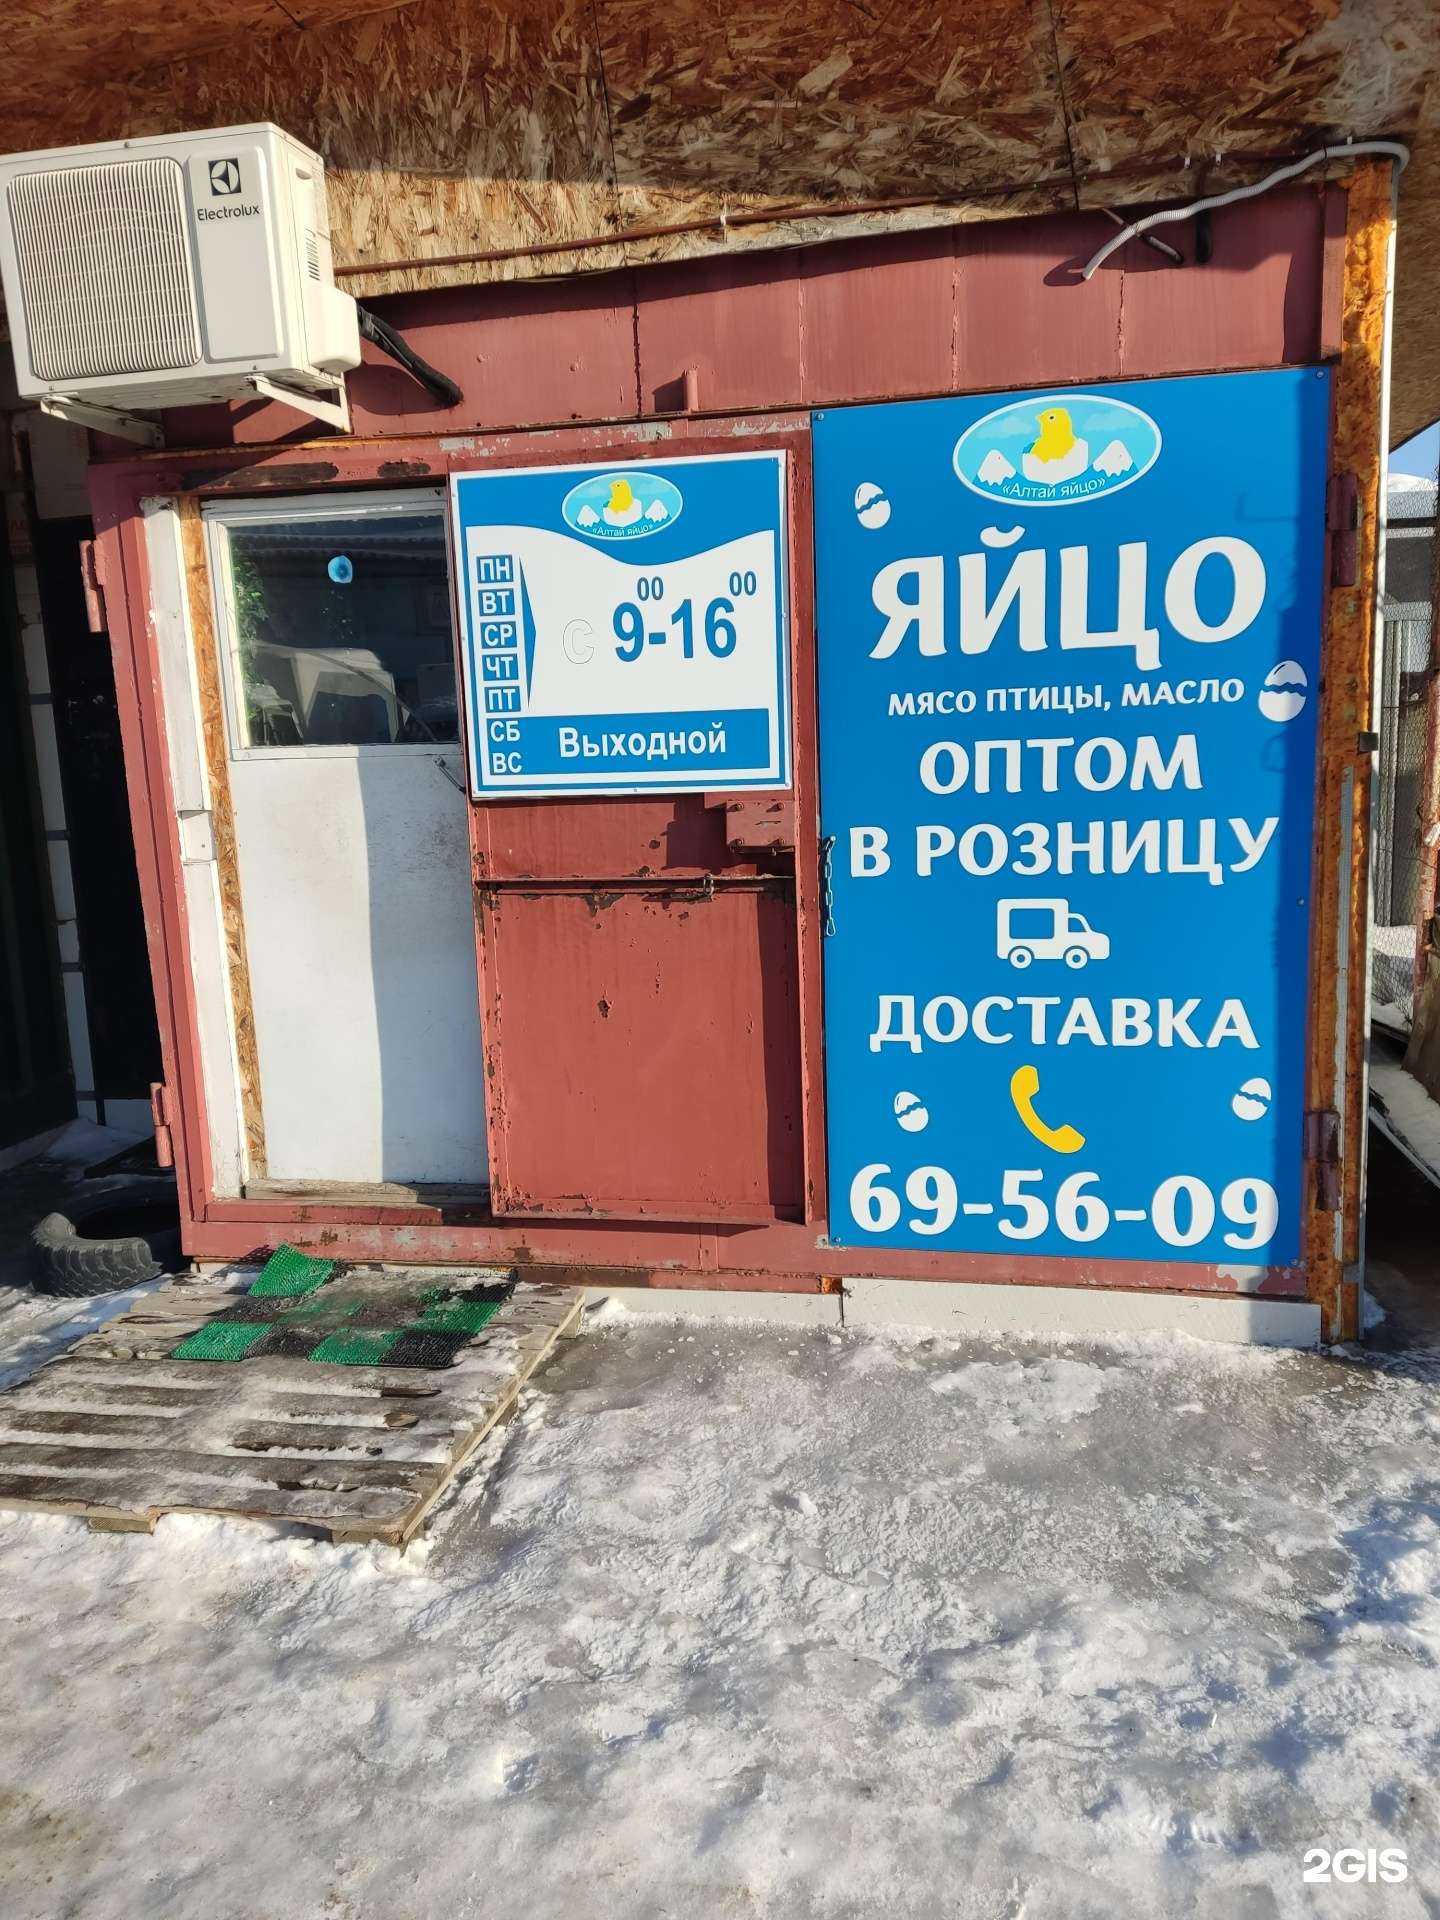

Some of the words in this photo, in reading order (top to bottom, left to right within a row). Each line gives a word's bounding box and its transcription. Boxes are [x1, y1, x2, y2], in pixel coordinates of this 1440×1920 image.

[197, 205, 260, 221] Electrolux
[1002, 482, 1056, 499] «Алтай
[1061, 477, 1106, 496] яйцо»
[479, 557, 511, 582] ПН
[482, 590, 511, 614] ВТ
[869, 525, 1267, 671] ЯЙЦО
[484, 623, 513, 646] СР
[485, 656, 515, 679] ЧТ
[488, 689, 516, 710] ПТ
[888, 691, 977, 716] МЯСО
[986, 684, 1111, 714] ПТИЦЫ,
[1121, 678, 1245, 707] МАСЛО
[490, 720, 520, 742] СБ
[558, 721, 727, 761] Выходной
[493, 752, 522, 774] ВС
[919, 734, 1203, 795] ОПТОМ
[849, 826, 891, 877] В
[916, 817, 1280, 885] РОЗНИЦУ
[869, 995, 1261, 1054] ДОСТАВКА
[849, 1163, 1280, 1250] 69-56-09
